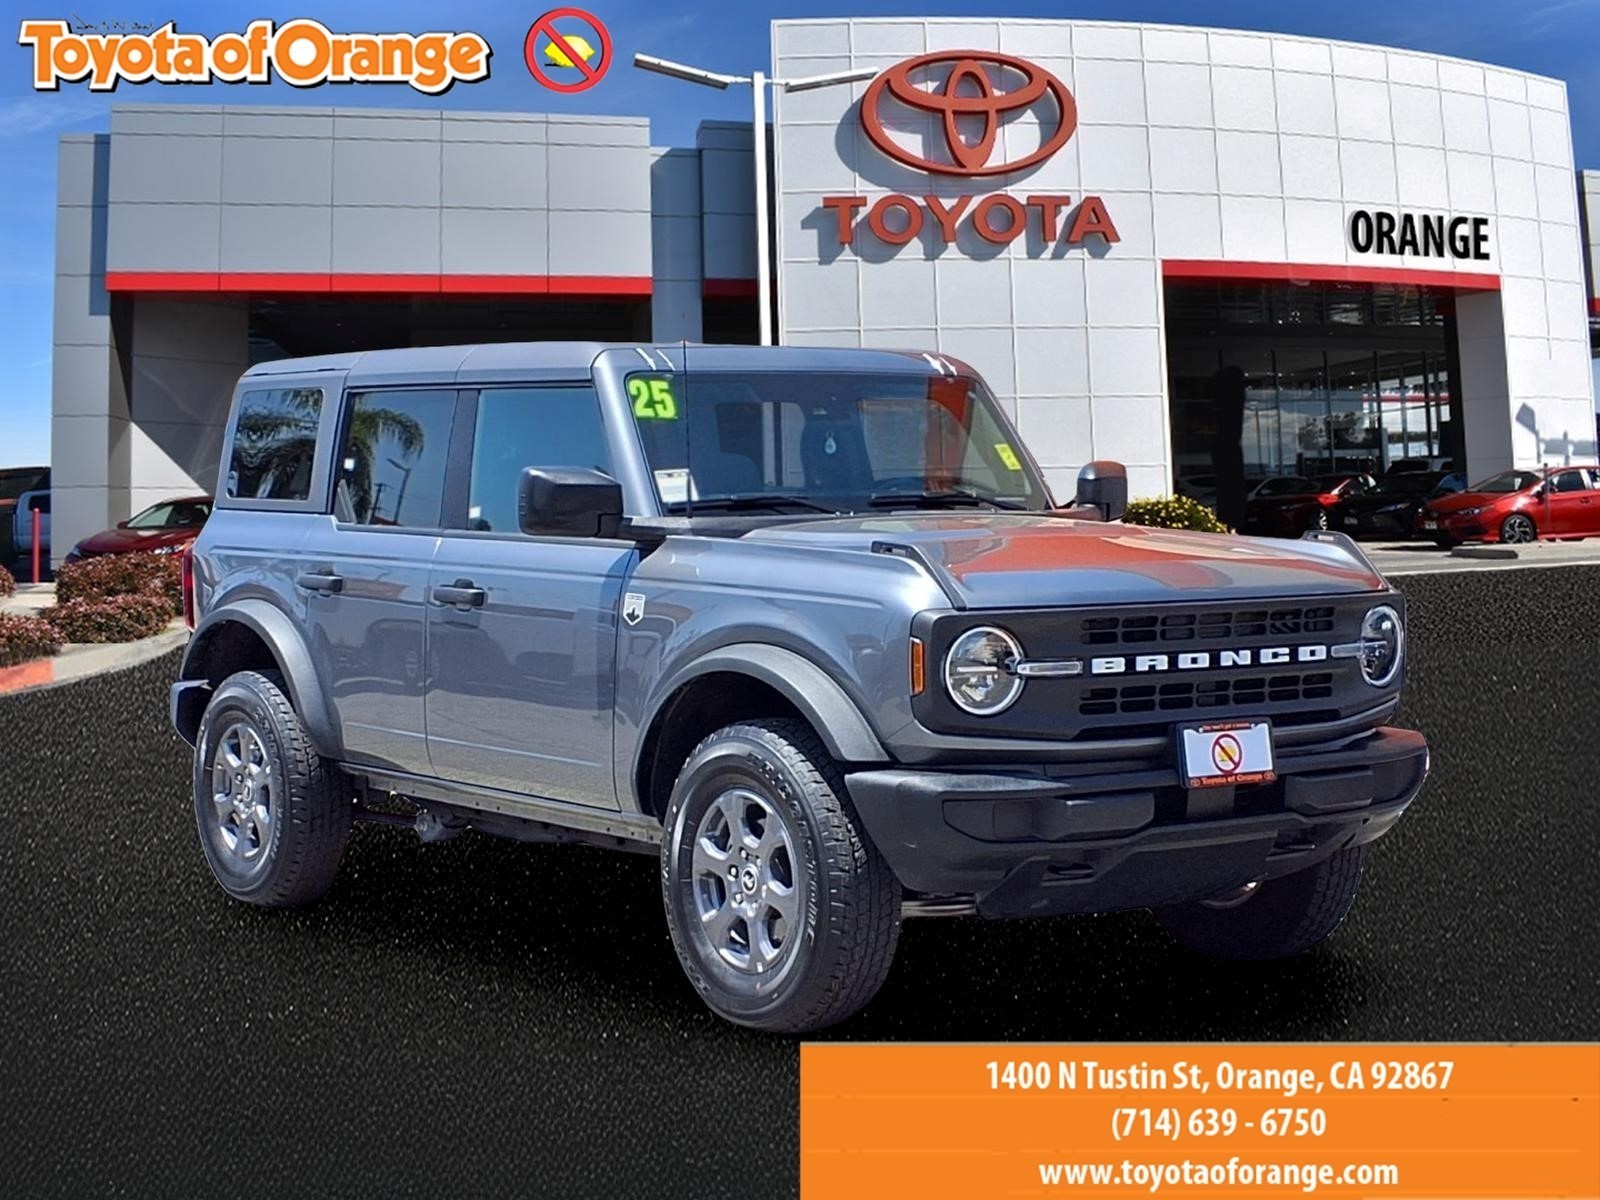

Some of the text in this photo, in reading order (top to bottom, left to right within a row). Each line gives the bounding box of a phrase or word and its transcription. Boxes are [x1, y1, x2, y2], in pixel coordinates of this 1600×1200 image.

[822, 194, 1121, 245] TOYOTA
[1350, 209, 1491, 261] ORANGE
[628, 378, 677, 420] 25
[1091, 645, 1327, 674] BRONCO
